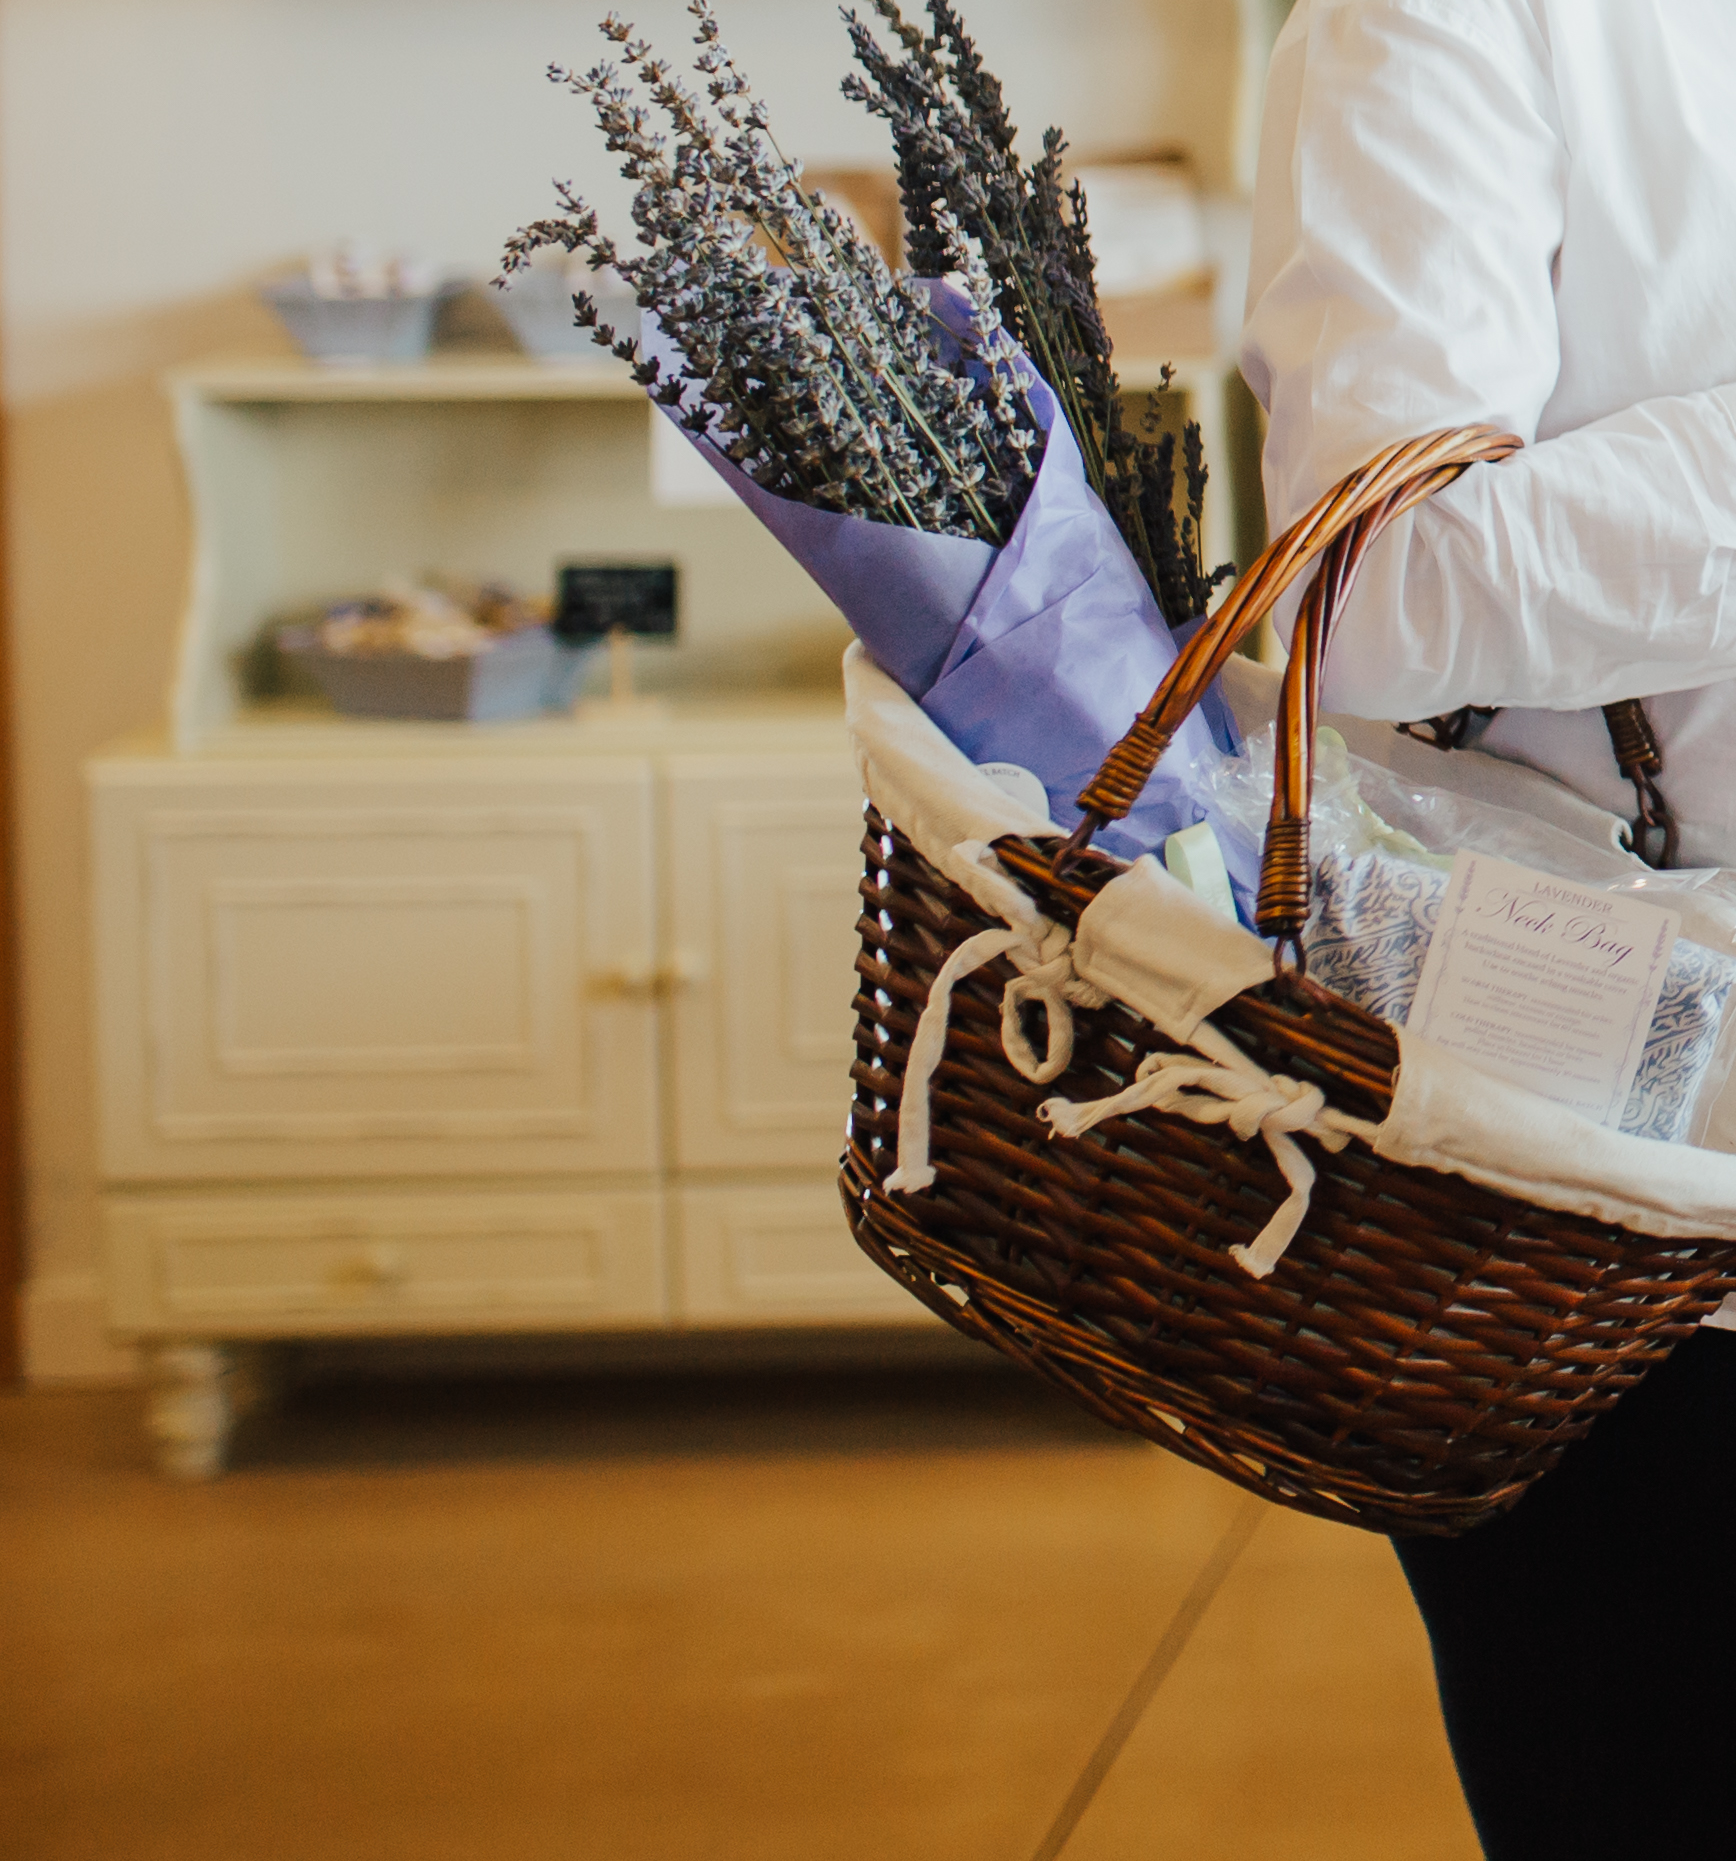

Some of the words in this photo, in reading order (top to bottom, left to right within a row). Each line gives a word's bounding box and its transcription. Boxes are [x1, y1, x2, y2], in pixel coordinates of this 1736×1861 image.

[1533, 881, 1613, 914] LAVENDER
[1476, 888, 1557, 935] Neck
[1561, 914, 1635, 969] Bag
